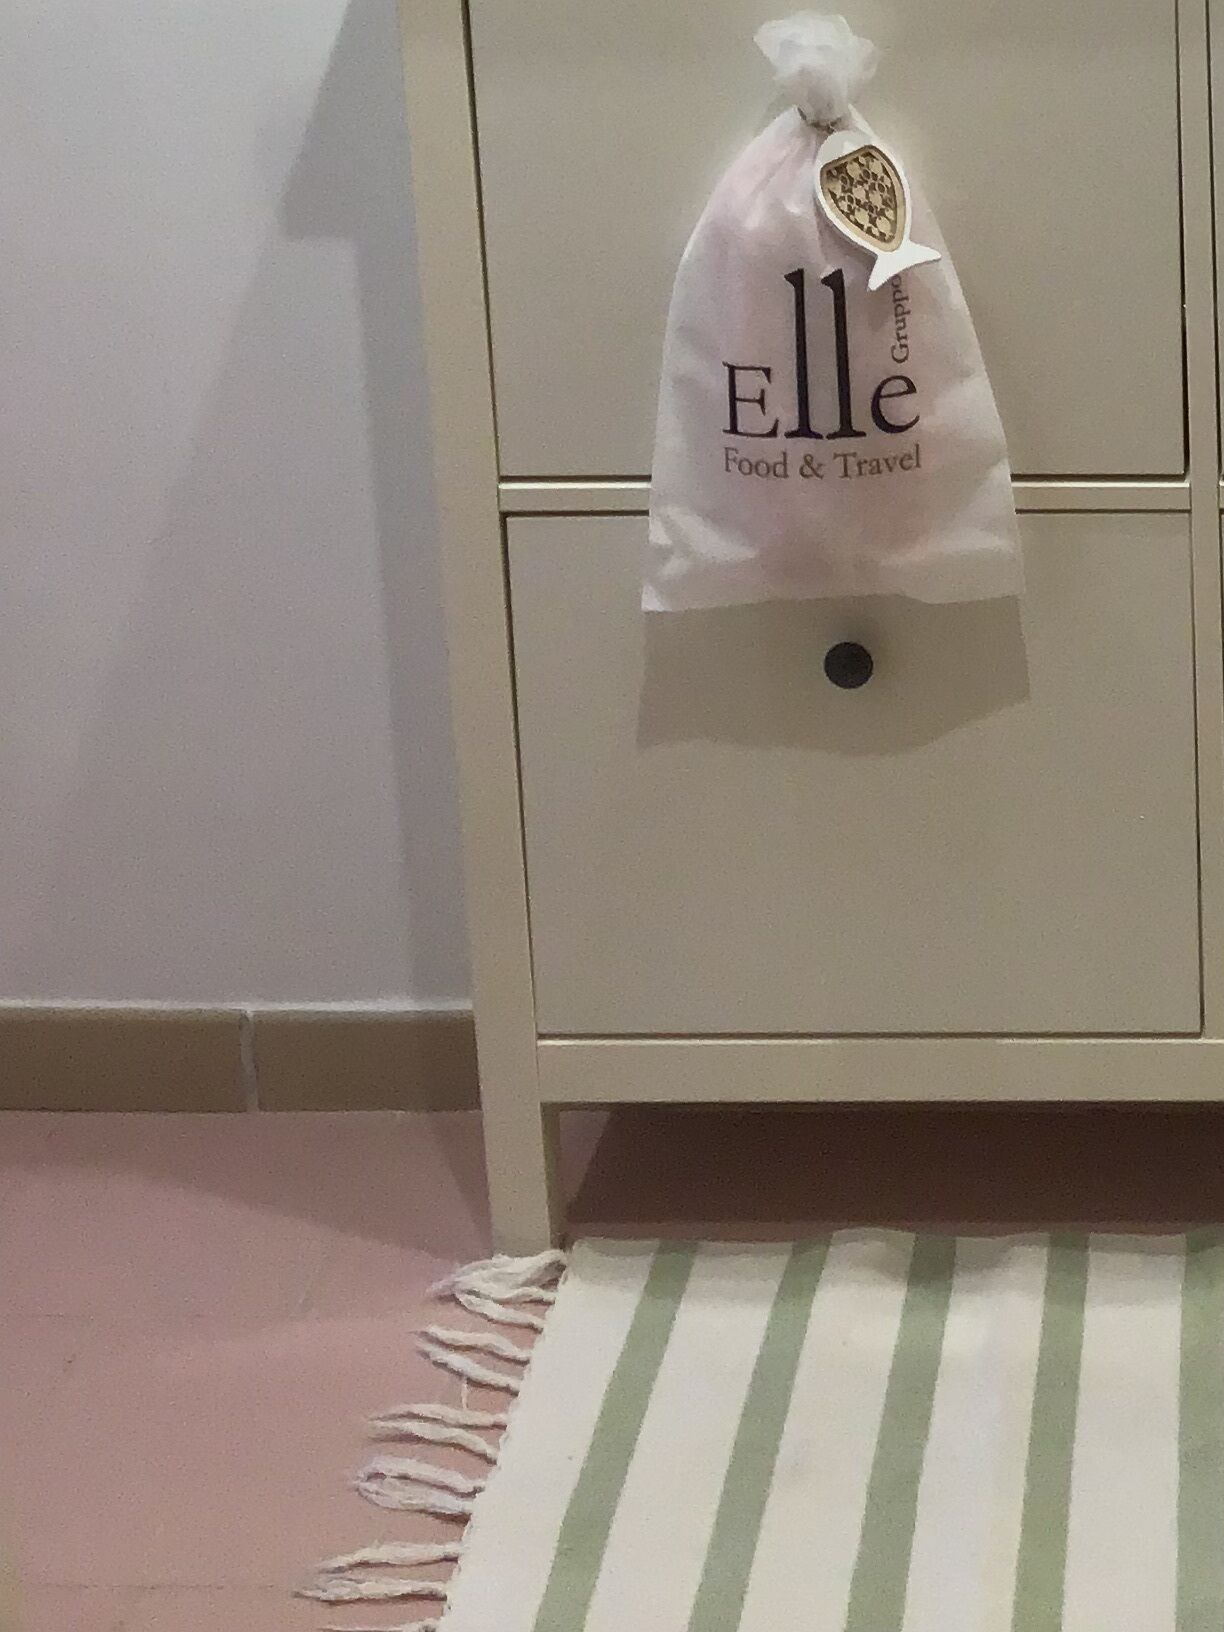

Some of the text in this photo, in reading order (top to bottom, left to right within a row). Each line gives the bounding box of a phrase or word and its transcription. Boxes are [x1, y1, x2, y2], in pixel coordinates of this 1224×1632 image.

[722, 268, 921, 439] Elle
[723, 443, 922, 480] Food & Travel
